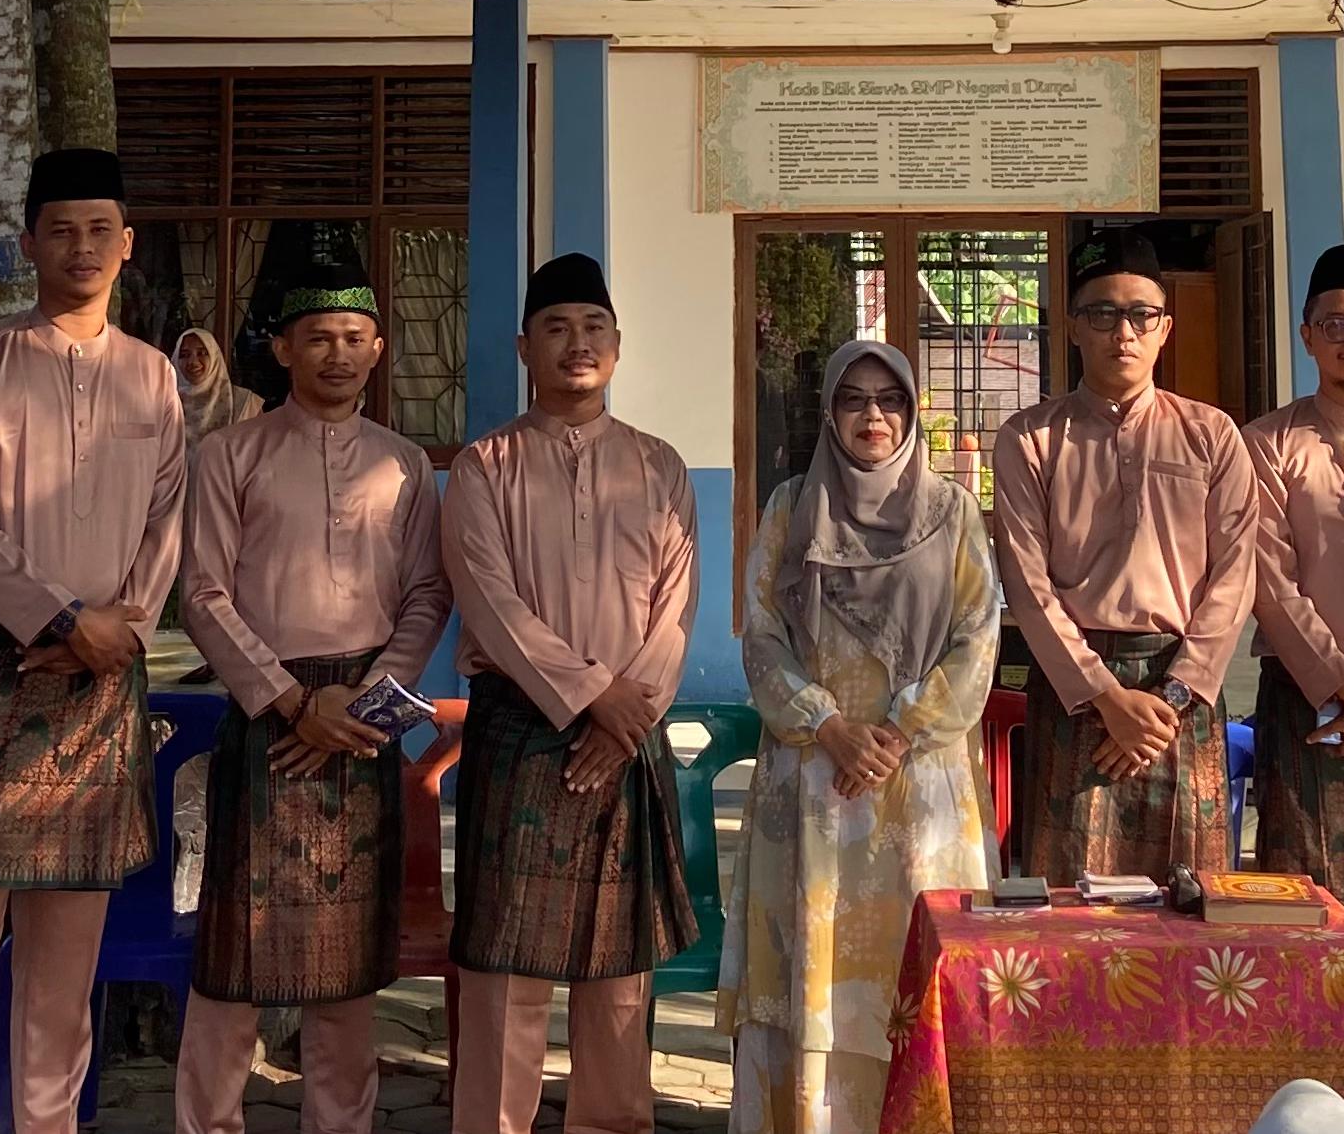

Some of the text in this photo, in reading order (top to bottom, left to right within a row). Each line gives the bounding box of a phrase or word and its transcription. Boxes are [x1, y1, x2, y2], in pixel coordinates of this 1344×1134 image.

[779, 81, 820, 96] Kode
[822, 81, 856, 96] Etik
[911, 80, 954, 95] SMP
[957, 80, 1009, 98] Negeri
